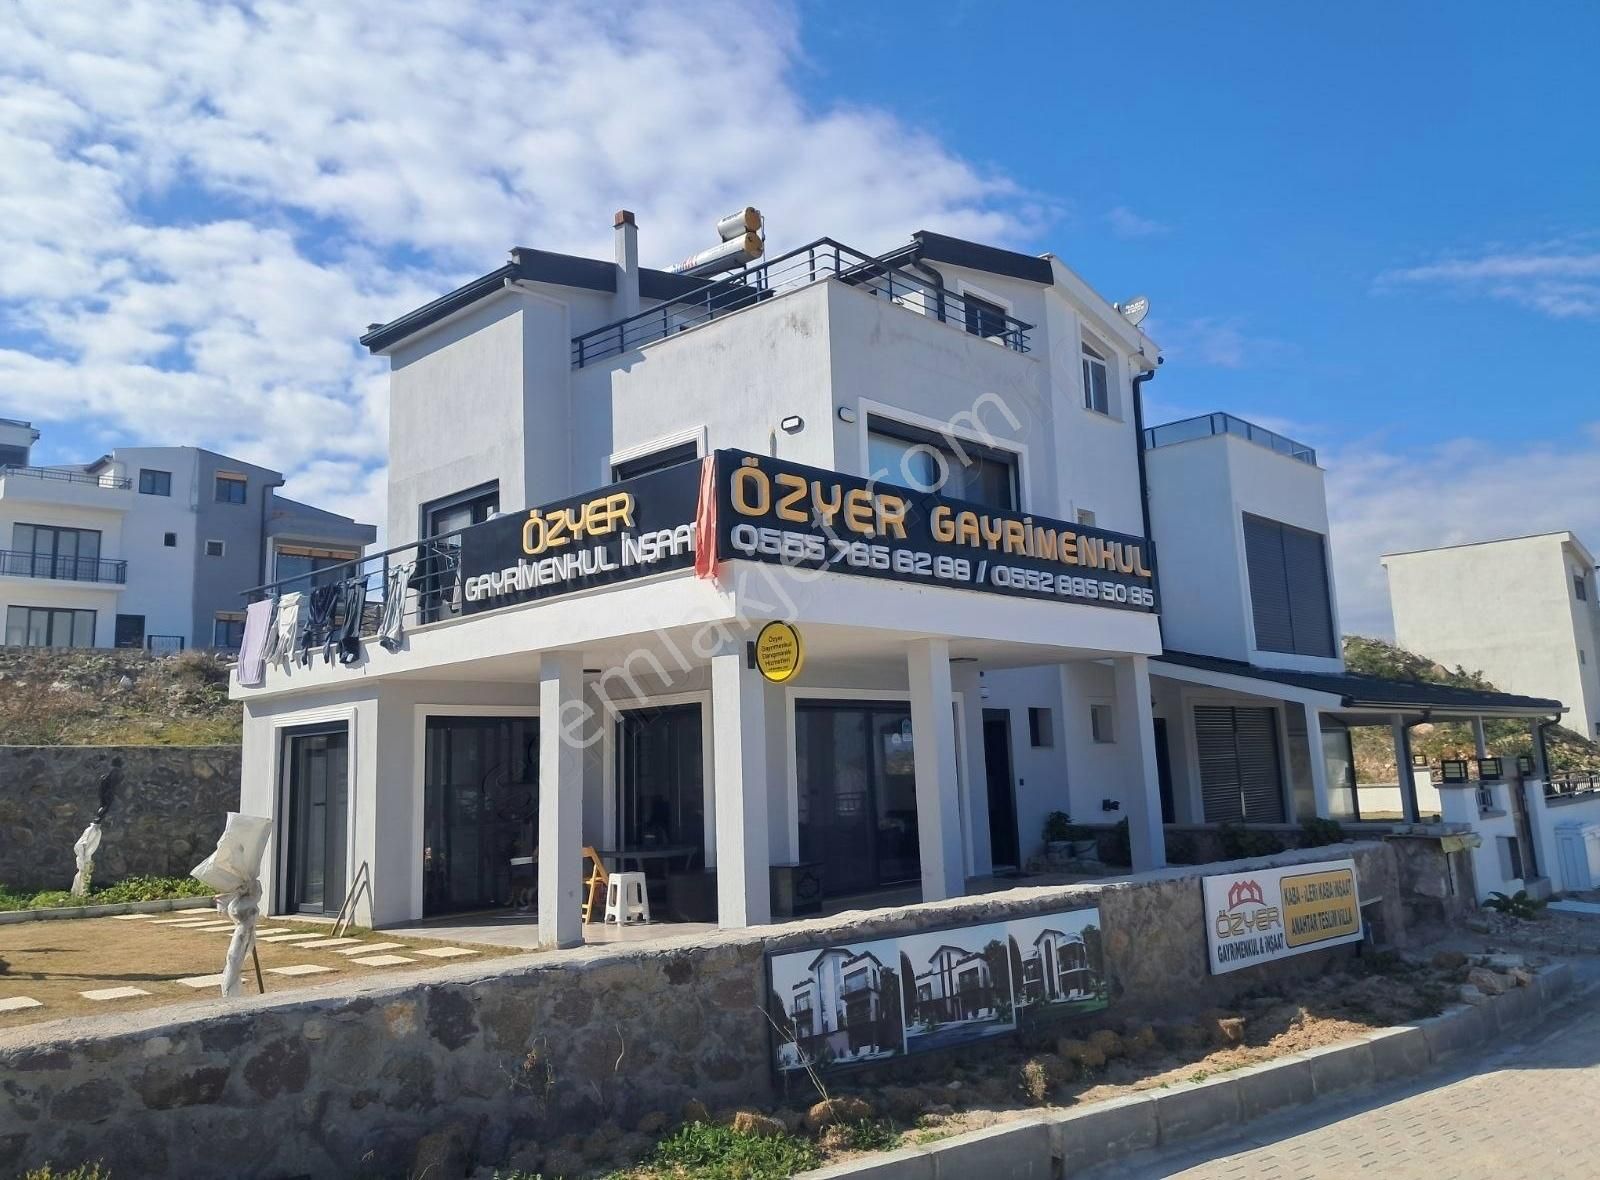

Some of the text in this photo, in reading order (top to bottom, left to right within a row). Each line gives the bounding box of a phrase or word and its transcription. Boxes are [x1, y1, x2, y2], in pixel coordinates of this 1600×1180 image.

[522, 492, 636, 555] ÖZYER
[730, 456, 1151, 577] ÖZYER GAYRİMENKUL
[465, 546, 619, 602] GAYRİMENKUL
[976, 560, 987, 583] /
[1216, 907, 1282, 938] ÖZYER
